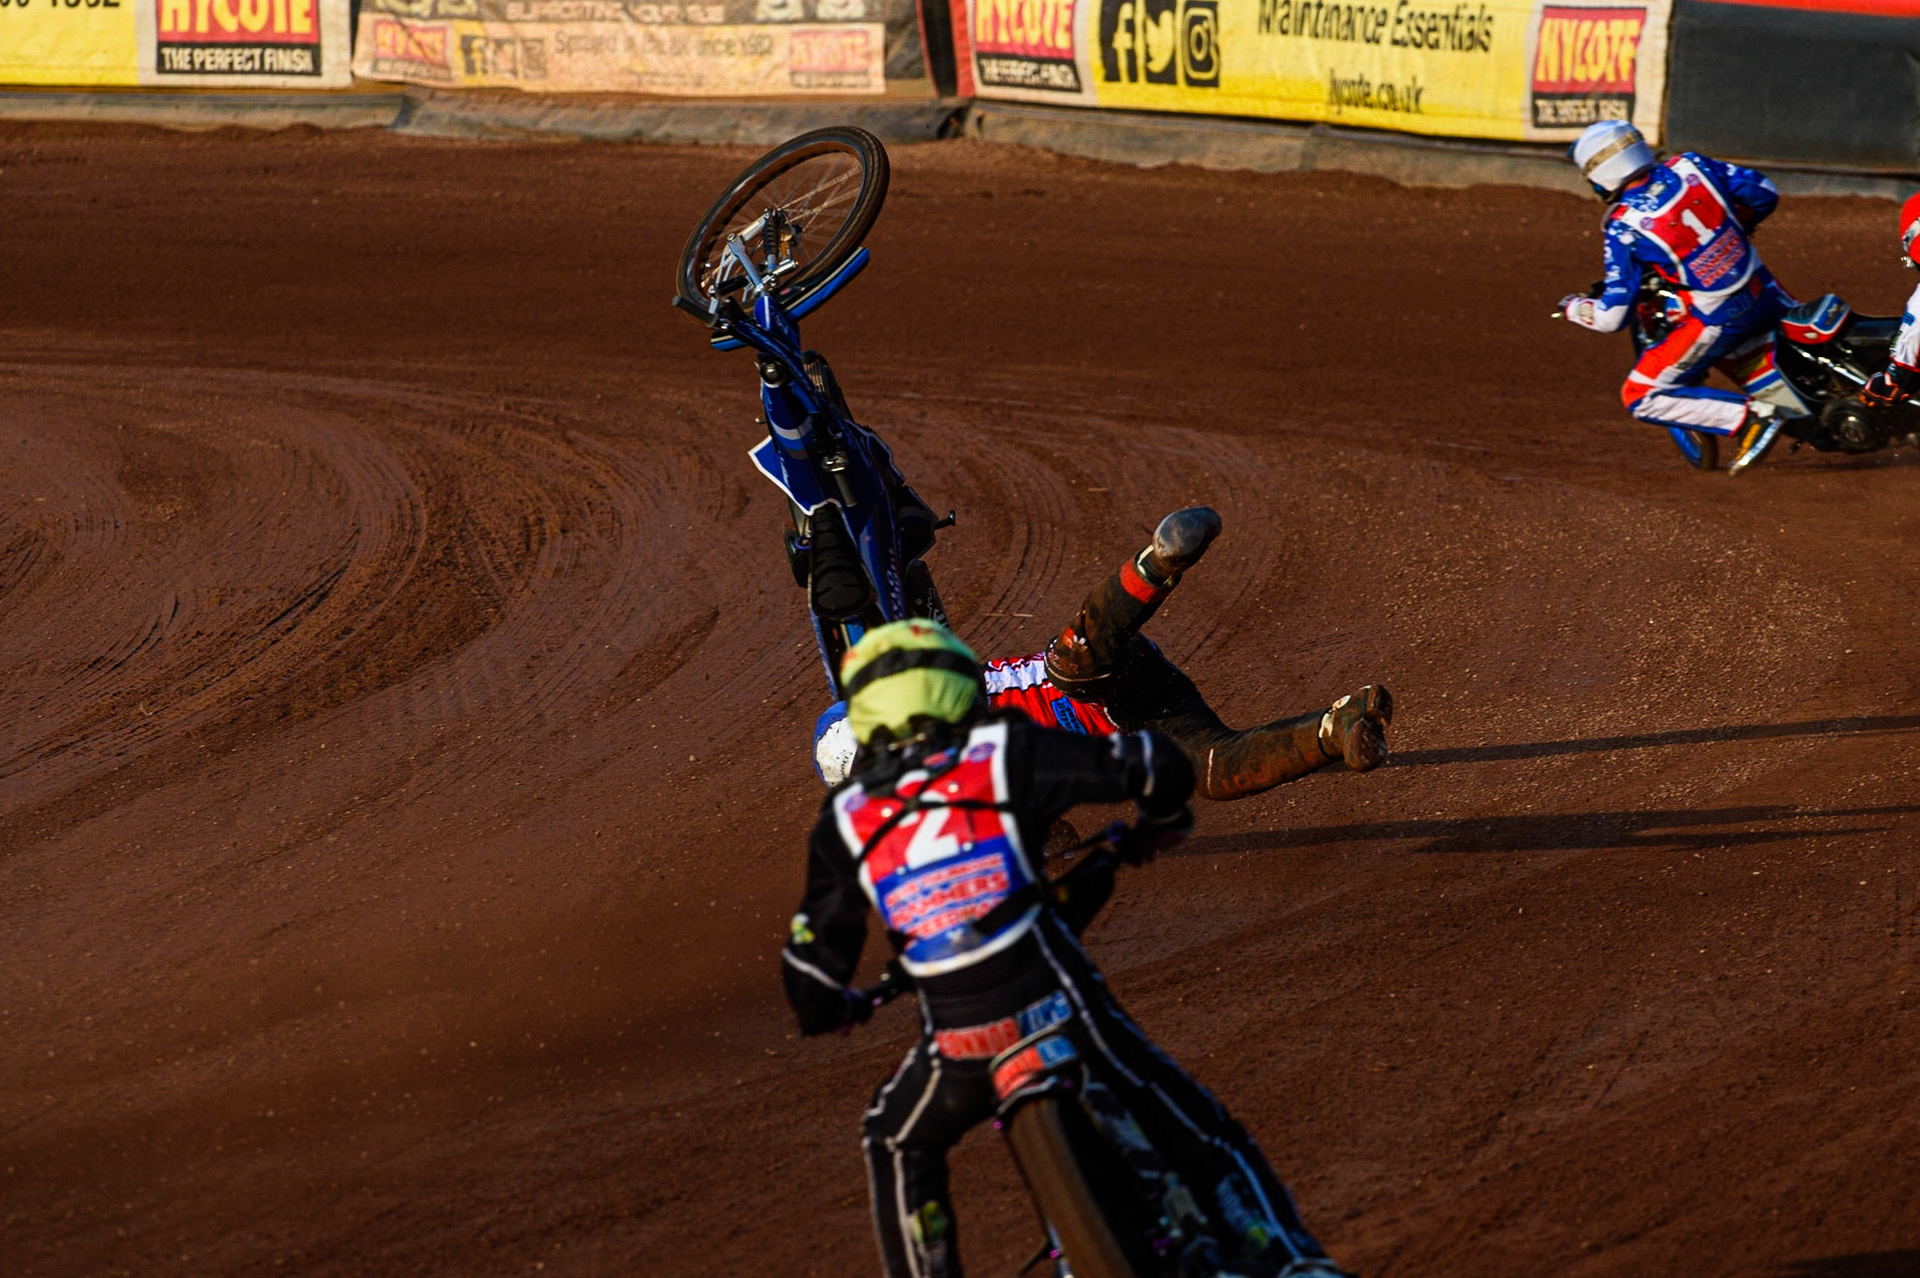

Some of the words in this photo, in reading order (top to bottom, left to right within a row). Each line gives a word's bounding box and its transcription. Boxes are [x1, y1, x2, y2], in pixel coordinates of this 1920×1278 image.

[162, 47, 191, 71] THE
[193, 47, 263, 72] PERFECT
[1681, 208, 1716, 246] 1
[897, 791, 960, 869] 2
